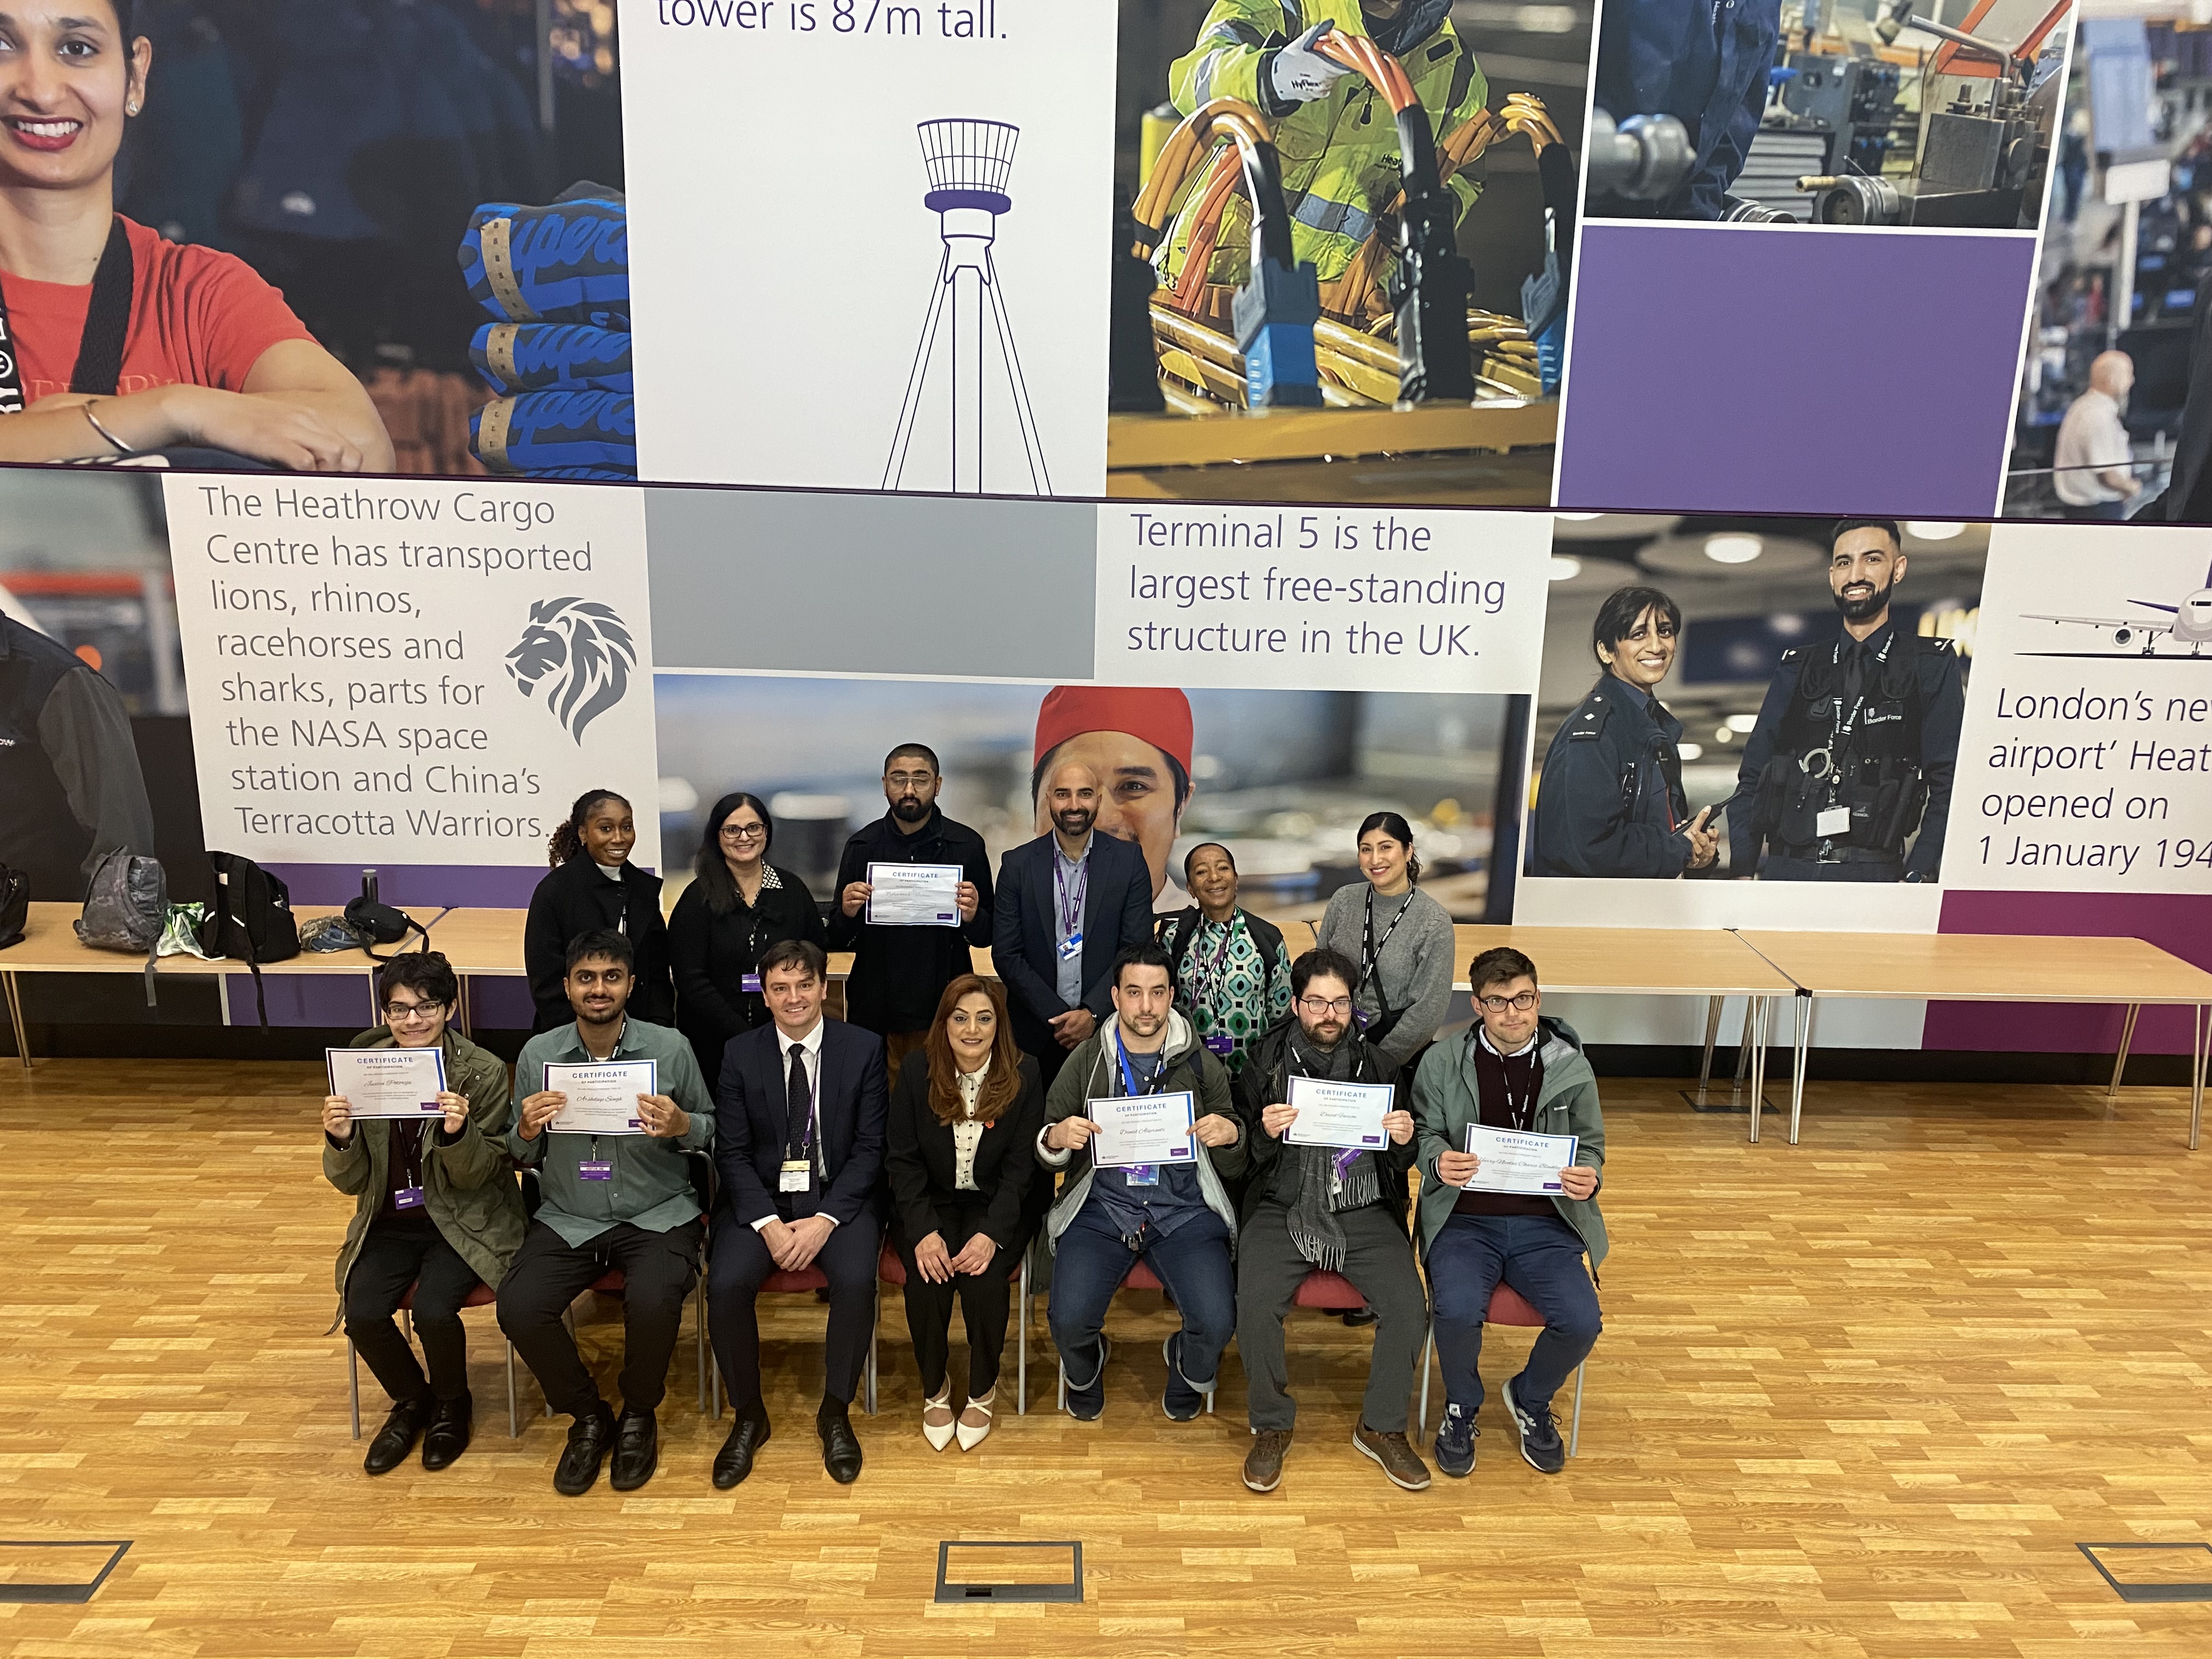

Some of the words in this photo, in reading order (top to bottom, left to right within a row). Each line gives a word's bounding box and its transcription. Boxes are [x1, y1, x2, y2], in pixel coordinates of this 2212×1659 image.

[658, 0, 775, 30] tower
[791, 0, 816, 32] is
[936, 0, 1007, 40] tall.
[198, 484, 262, 517] The
[275, 488, 441, 521] Heathrow
[453, 492, 555, 532] Cargo
[1130, 513, 1283, 549] Terminal
[1299, 516, 1318, 549] 5
[1334, 515, 1358, 550] is
[1372, 516, 1431, 552] the
[206, 534, 319, 566] Centre
[331, 535, 388, 567] has
[398, 540, 592, 577] transported
[211, 579, 297, 617] lions,
[311, 581, 421, 619] rhinos,
[1131, 564, 1250, 609] largest
[1263, 566, 1505, 614] free-standing
[217, 627, 392, 659] racehorses
[404, 630, 464, 661] and
[1127, 620, 1287, 653] structure
[1301, 620, 1330, 654] in
[1345, 620, 1403, 656] the
[1419, 624, 1479, 657] UK.
[221, 671, 334, 708] sharks,
[347, 678, 428, 711] parts
[438, 675, 486, 706] for
[1996, 686, 2154, 721] London's
[2165, 698, 2212, 723] ne
[225, 716, 279, 747] the
[291, 719, 387, 748] NASA
[398, 727, 488, 757] space
[1867, 716, 1887, 724] Border
[1988, 736, 2118, 777] airport'
[231, 762, 340, 792] station
[353, 763, 413, 793] and
[425, 764, 540, 795] China's
[233, 806, 395, 836] Terracotta
[405, 809, 550, 838] Warriors.
[1981, 787, 2114, 826] opened
[2125, 797, 2169, 820] on
[1979, 835, 1991, 865] 1
[2005, 836, 2141, 876] January
[572, 1071, 628, 1079] CERTIFICATE
[1316, 1088, 1367, 1098] CERTIFICATE
[1116, 1103, 1167, 1113] CERTIFICATE
[1496, 1136, 1549, 1148] CERTIFICATE
